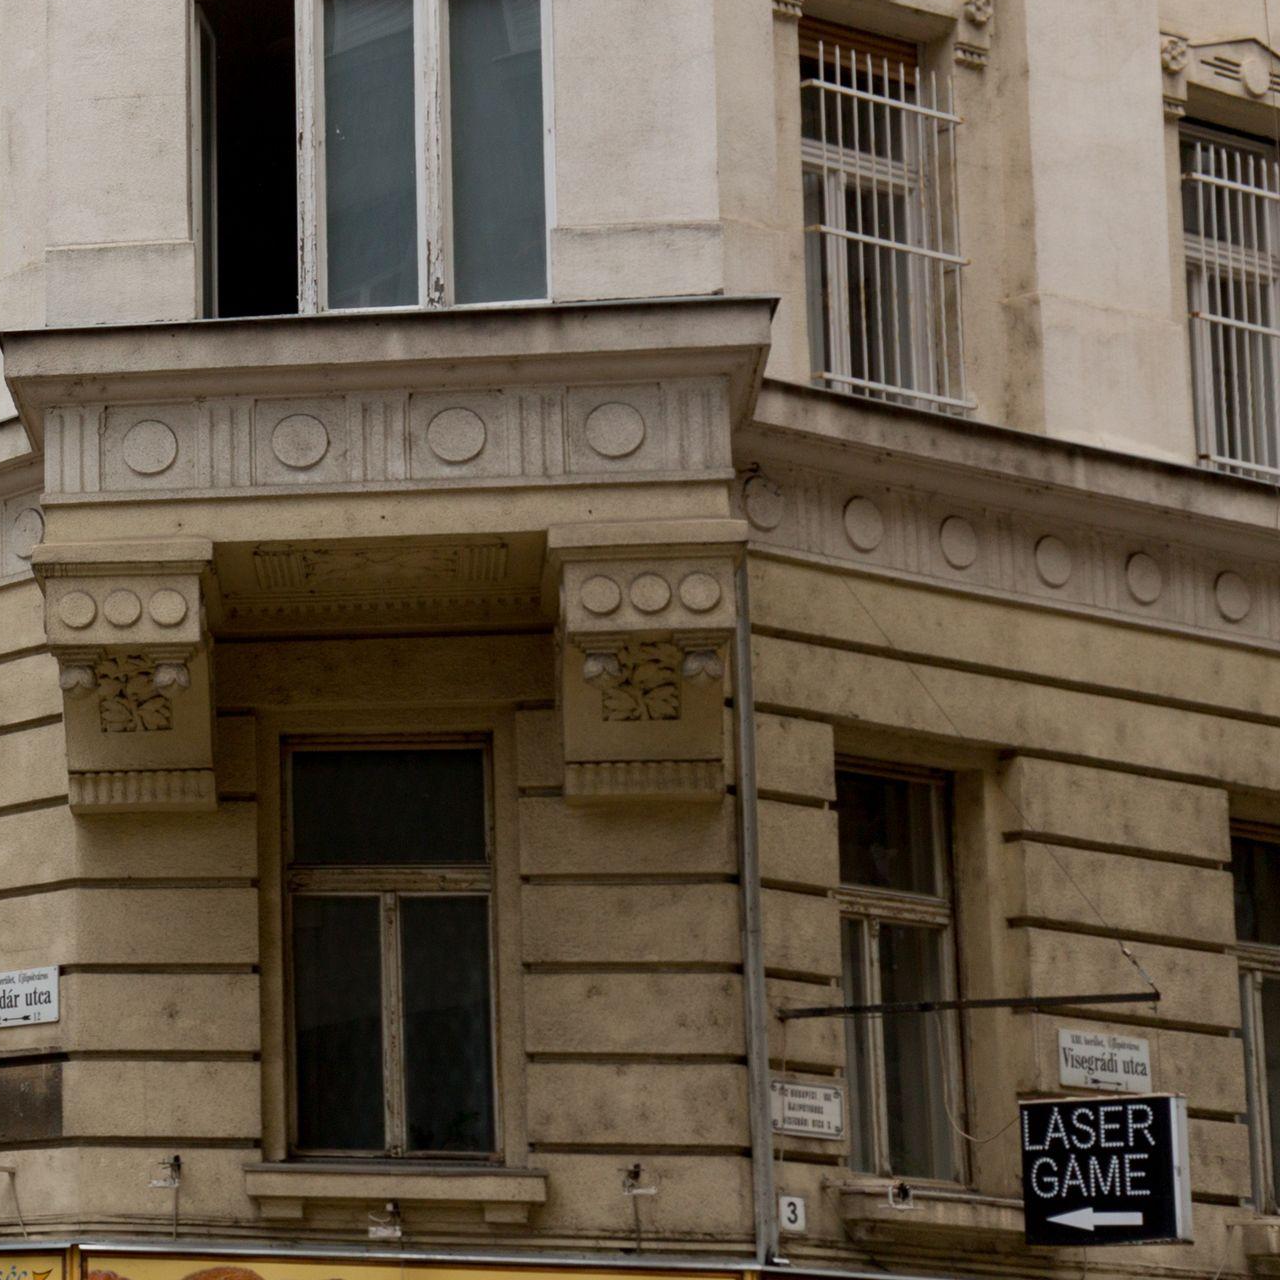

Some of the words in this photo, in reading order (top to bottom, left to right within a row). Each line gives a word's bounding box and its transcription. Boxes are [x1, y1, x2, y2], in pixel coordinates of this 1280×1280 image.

[25, 986, 52, 1007] utca
[1062, 1047, 1118, 1075] Visegrádi
[1123, 1056, 1148, 1077] utca
[1023, 1104, 1155, 1151] LASER
[1031, 1153, 1151, 1198] GAME
[787, 1201, 798, 1224] 3
